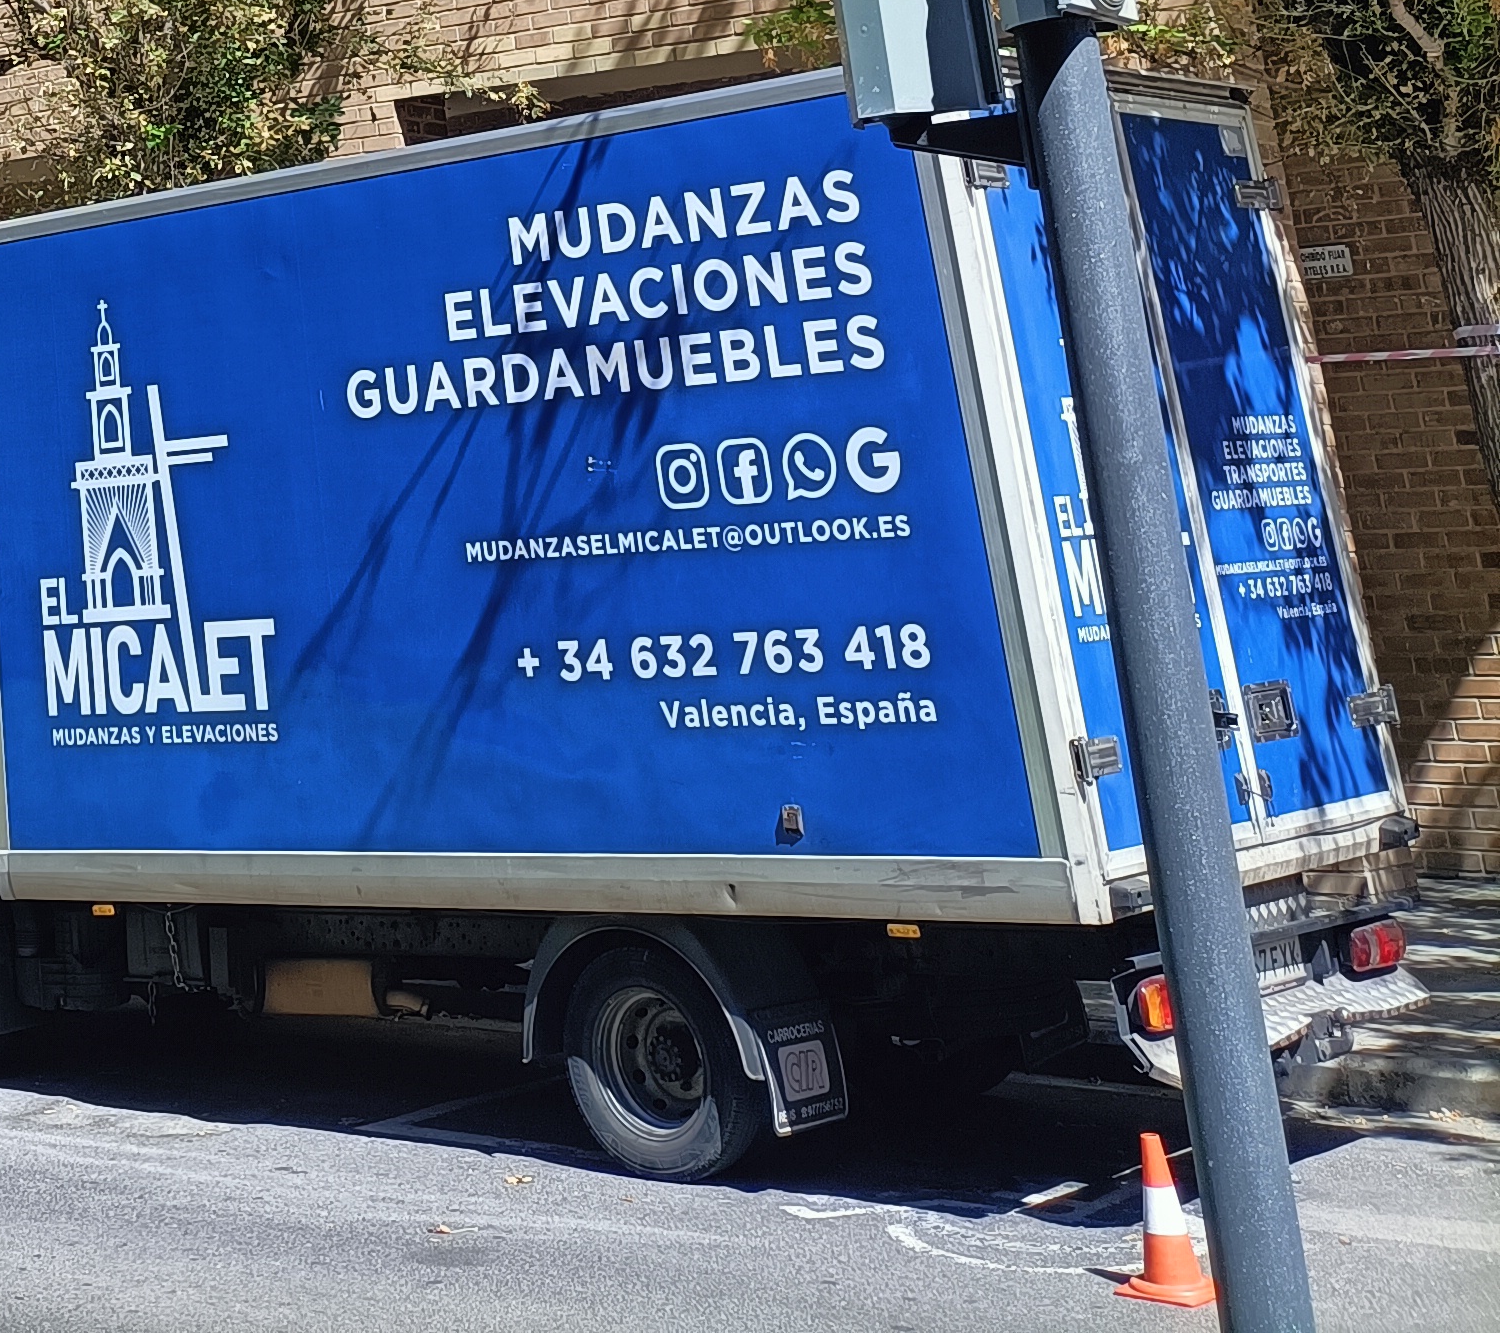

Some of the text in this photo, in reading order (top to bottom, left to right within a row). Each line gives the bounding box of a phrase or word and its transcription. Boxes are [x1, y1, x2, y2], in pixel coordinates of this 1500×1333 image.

[508, 169, 860, 266] MUDANZAS
[444, 241, 873, 342] ELEVACIONES
[346, 314, 885, 419] GUARDAMUEBLES
[1231, 414, 1297, 435] MUDANZAS
[845, 427, 901, 494] G
[1222, 438, 1302, 460] ELEVACIONES
[1223, 461, 1307, 485] TRANSPORTES
[1211, 485, 1312, 510] GUARDAMUEBLES
[466, 514, 911, 563] MUDANZASELMICALET@OUTLOOK.ES
[40, 577, 79, 627] EL
[1248, 577, 1265, 600] 34
[1266, 576, 1289, 598] 632
[1289, 573, 1312, 596] 763
[1314, 571, 1333, 593] 418
[43, 618, 276, 717] MICALET
[557, 638, 614, 682] 34
[630, 633, 718, 679] 632
[732, 628, 824, 675] 763
[844, 623, 931, 670] 418
[659, 691, 938, 731] Valencia, España
[52, 723, 279, 746] MUDANZAS Y ELEVACIONES
[1269, 940, 1301, 979] FXK
[767, 1019, 825, 1044] CARROCERIAS
[785, 1049, 825, 1093] CIR
